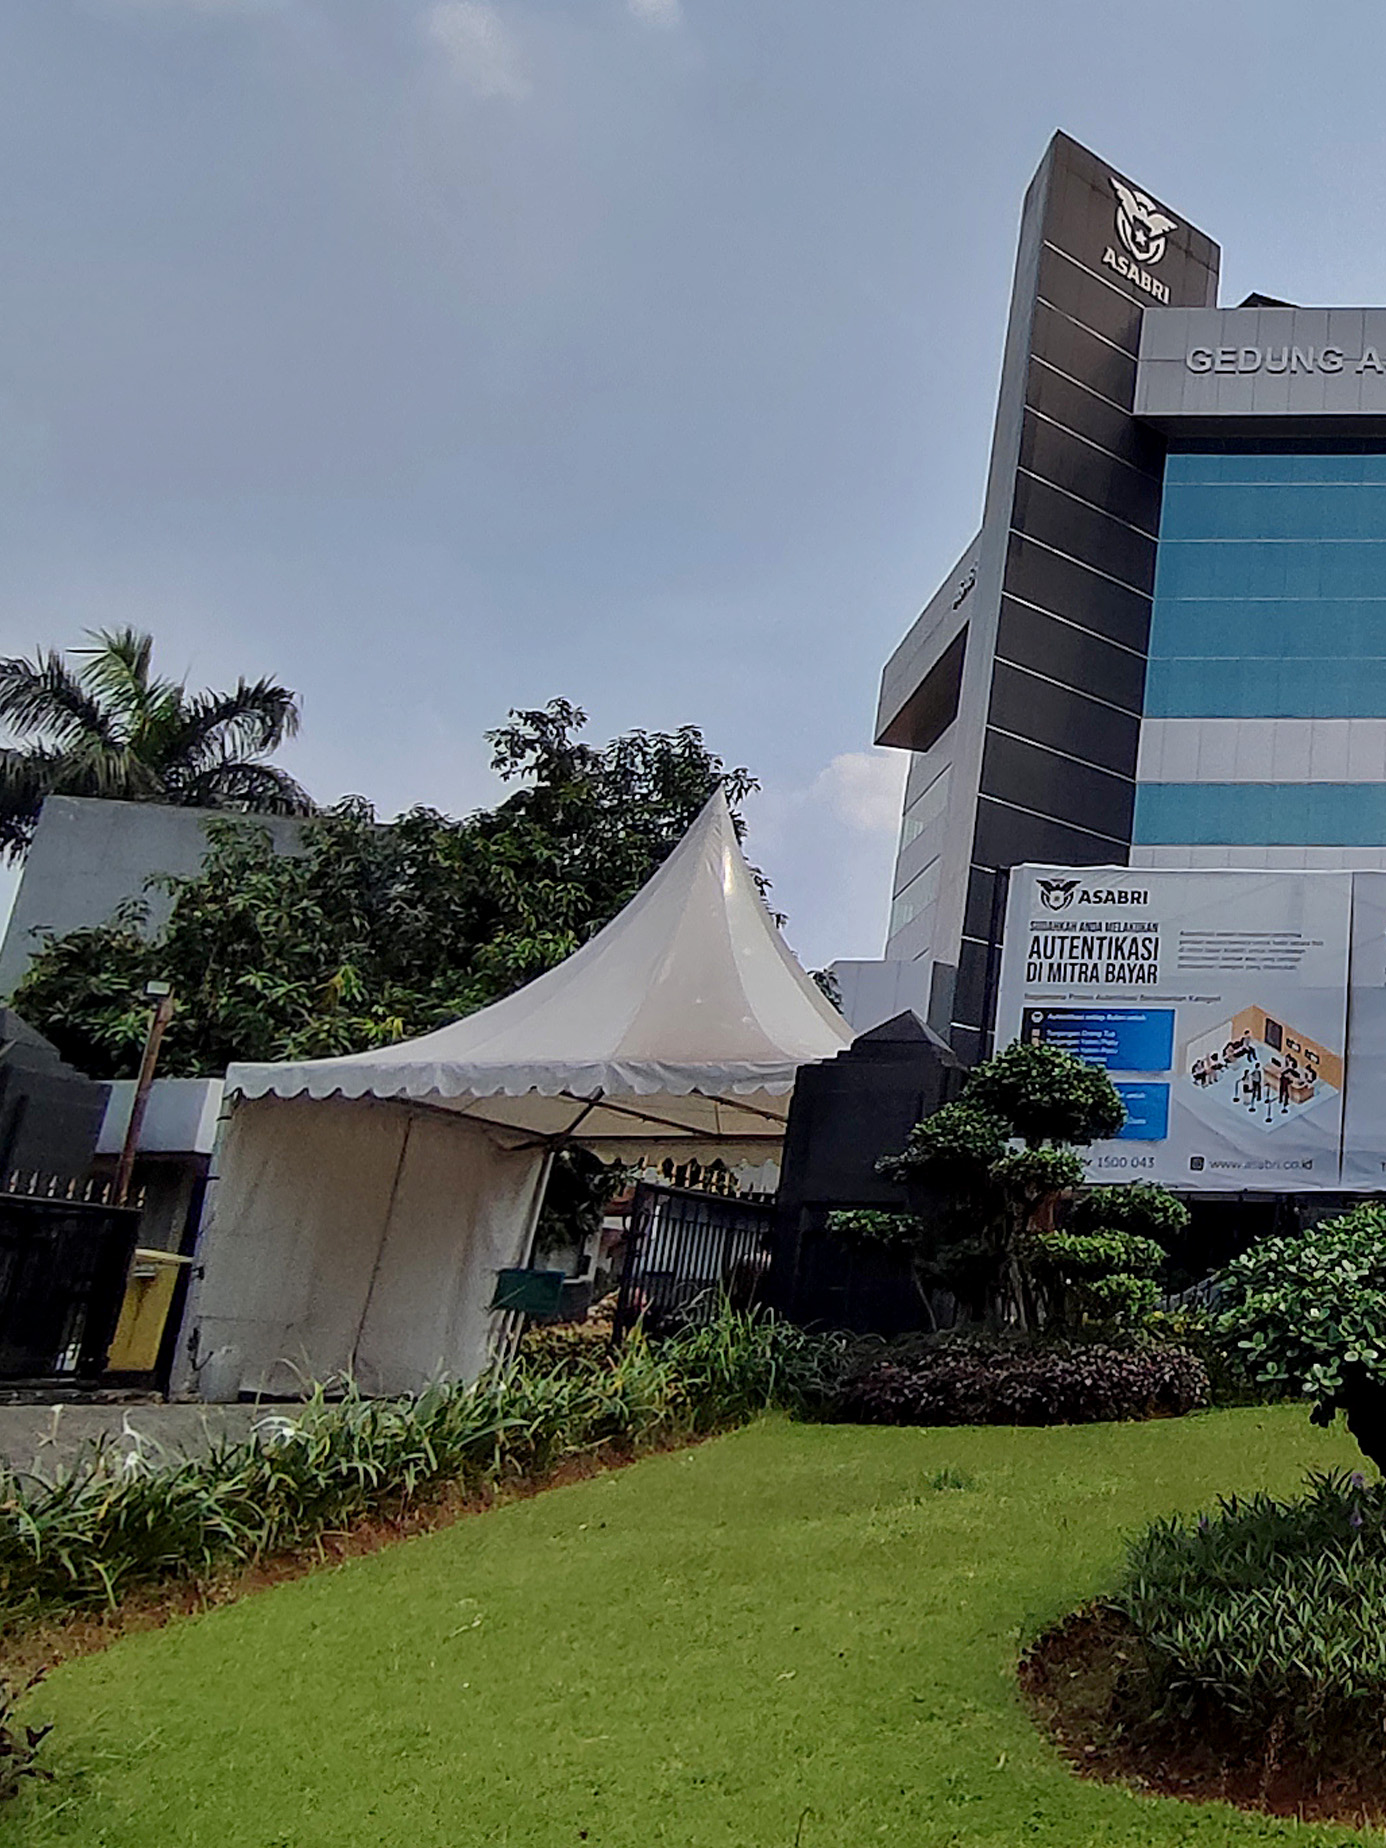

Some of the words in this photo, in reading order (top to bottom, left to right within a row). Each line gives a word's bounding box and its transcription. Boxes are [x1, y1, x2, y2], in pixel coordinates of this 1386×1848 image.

[1102, 246, 1170, 305] ASABRI
[1186, 346, 1344, 374] GEDUNG
[1078, 889, 1149, 905] ASABRI
[1028, 935, 1160, 960] AUTENTIKASI
[1026, 961, 1043, 983] DI
[1047, 962, 1100, 983] MITRA
[1104, 962, 1158, 984] BAYAR
